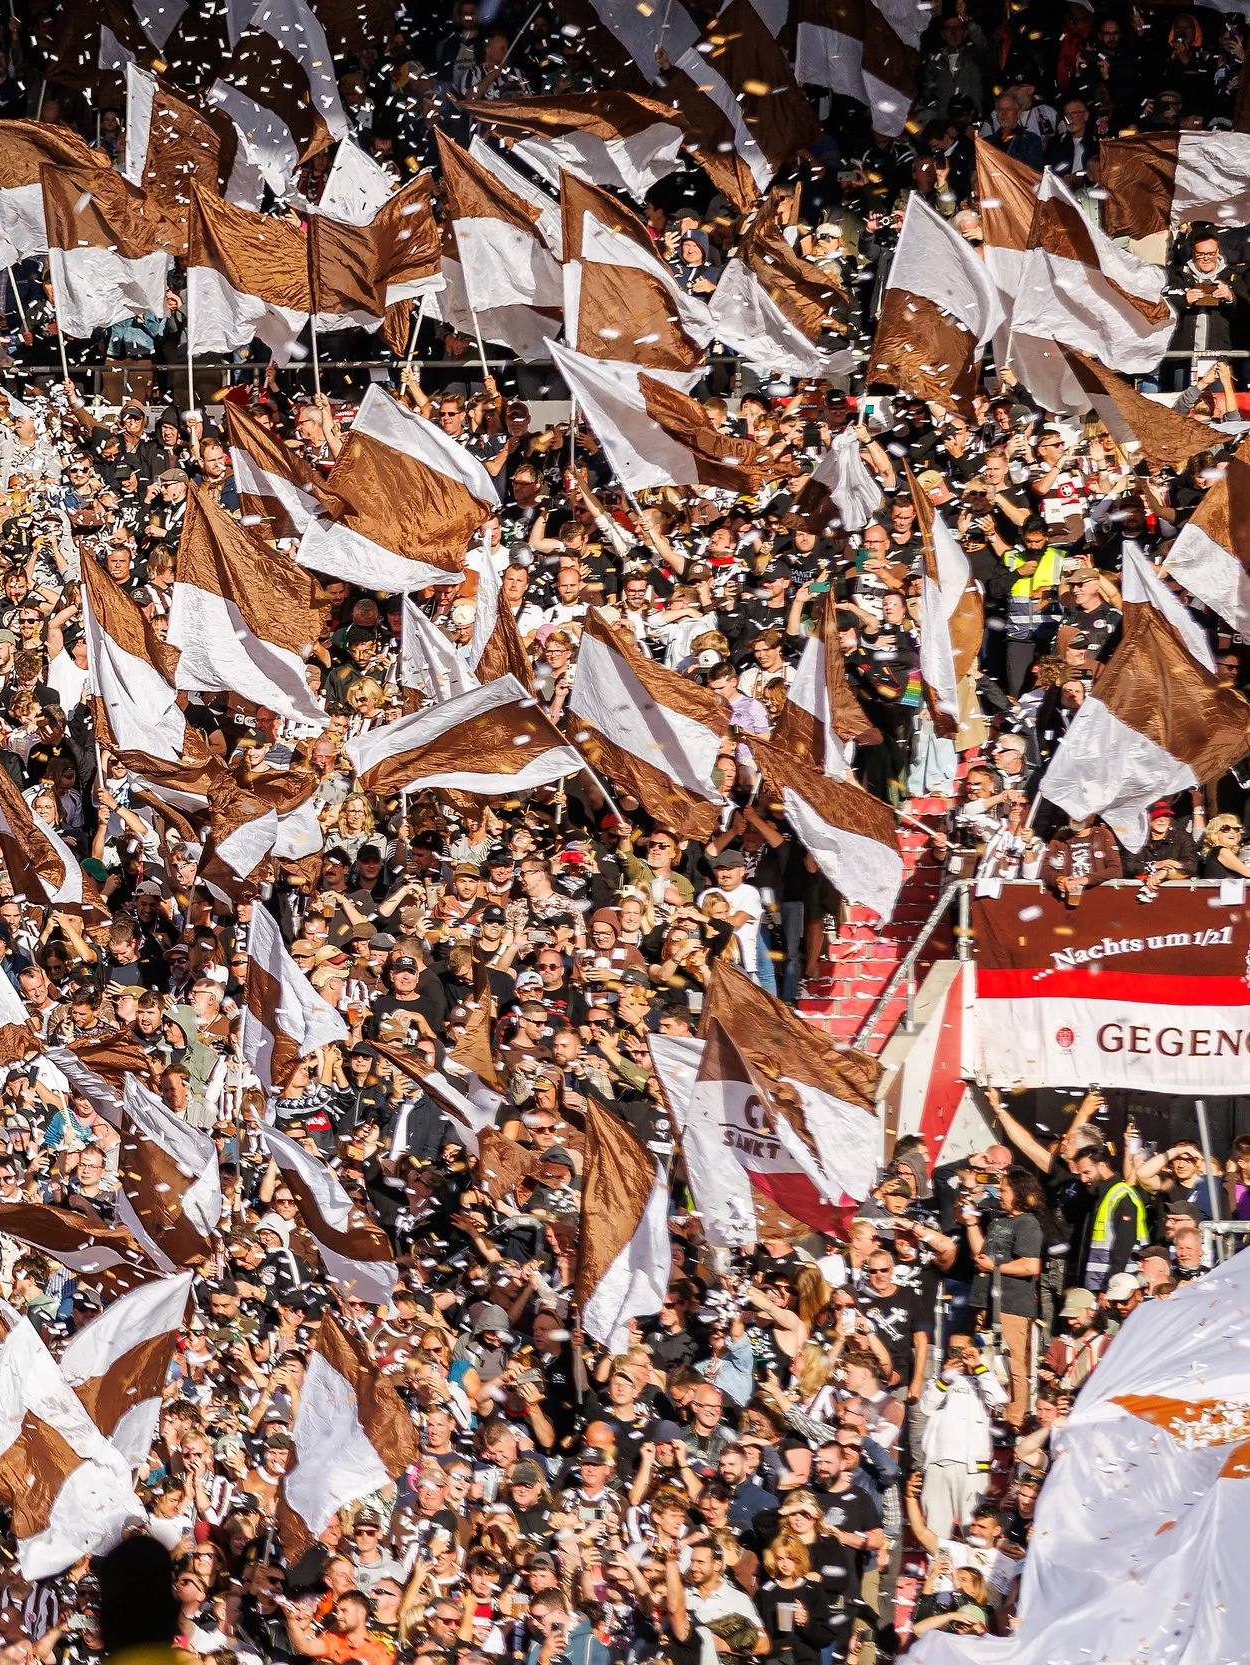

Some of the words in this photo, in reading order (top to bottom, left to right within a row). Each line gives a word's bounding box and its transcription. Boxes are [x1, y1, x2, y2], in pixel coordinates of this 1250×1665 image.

[1146, 930, 1191, 950] um
[1096, 1022, 1250, 1057] GEGEN
[722, 1130, 781, 1160] SANKT
